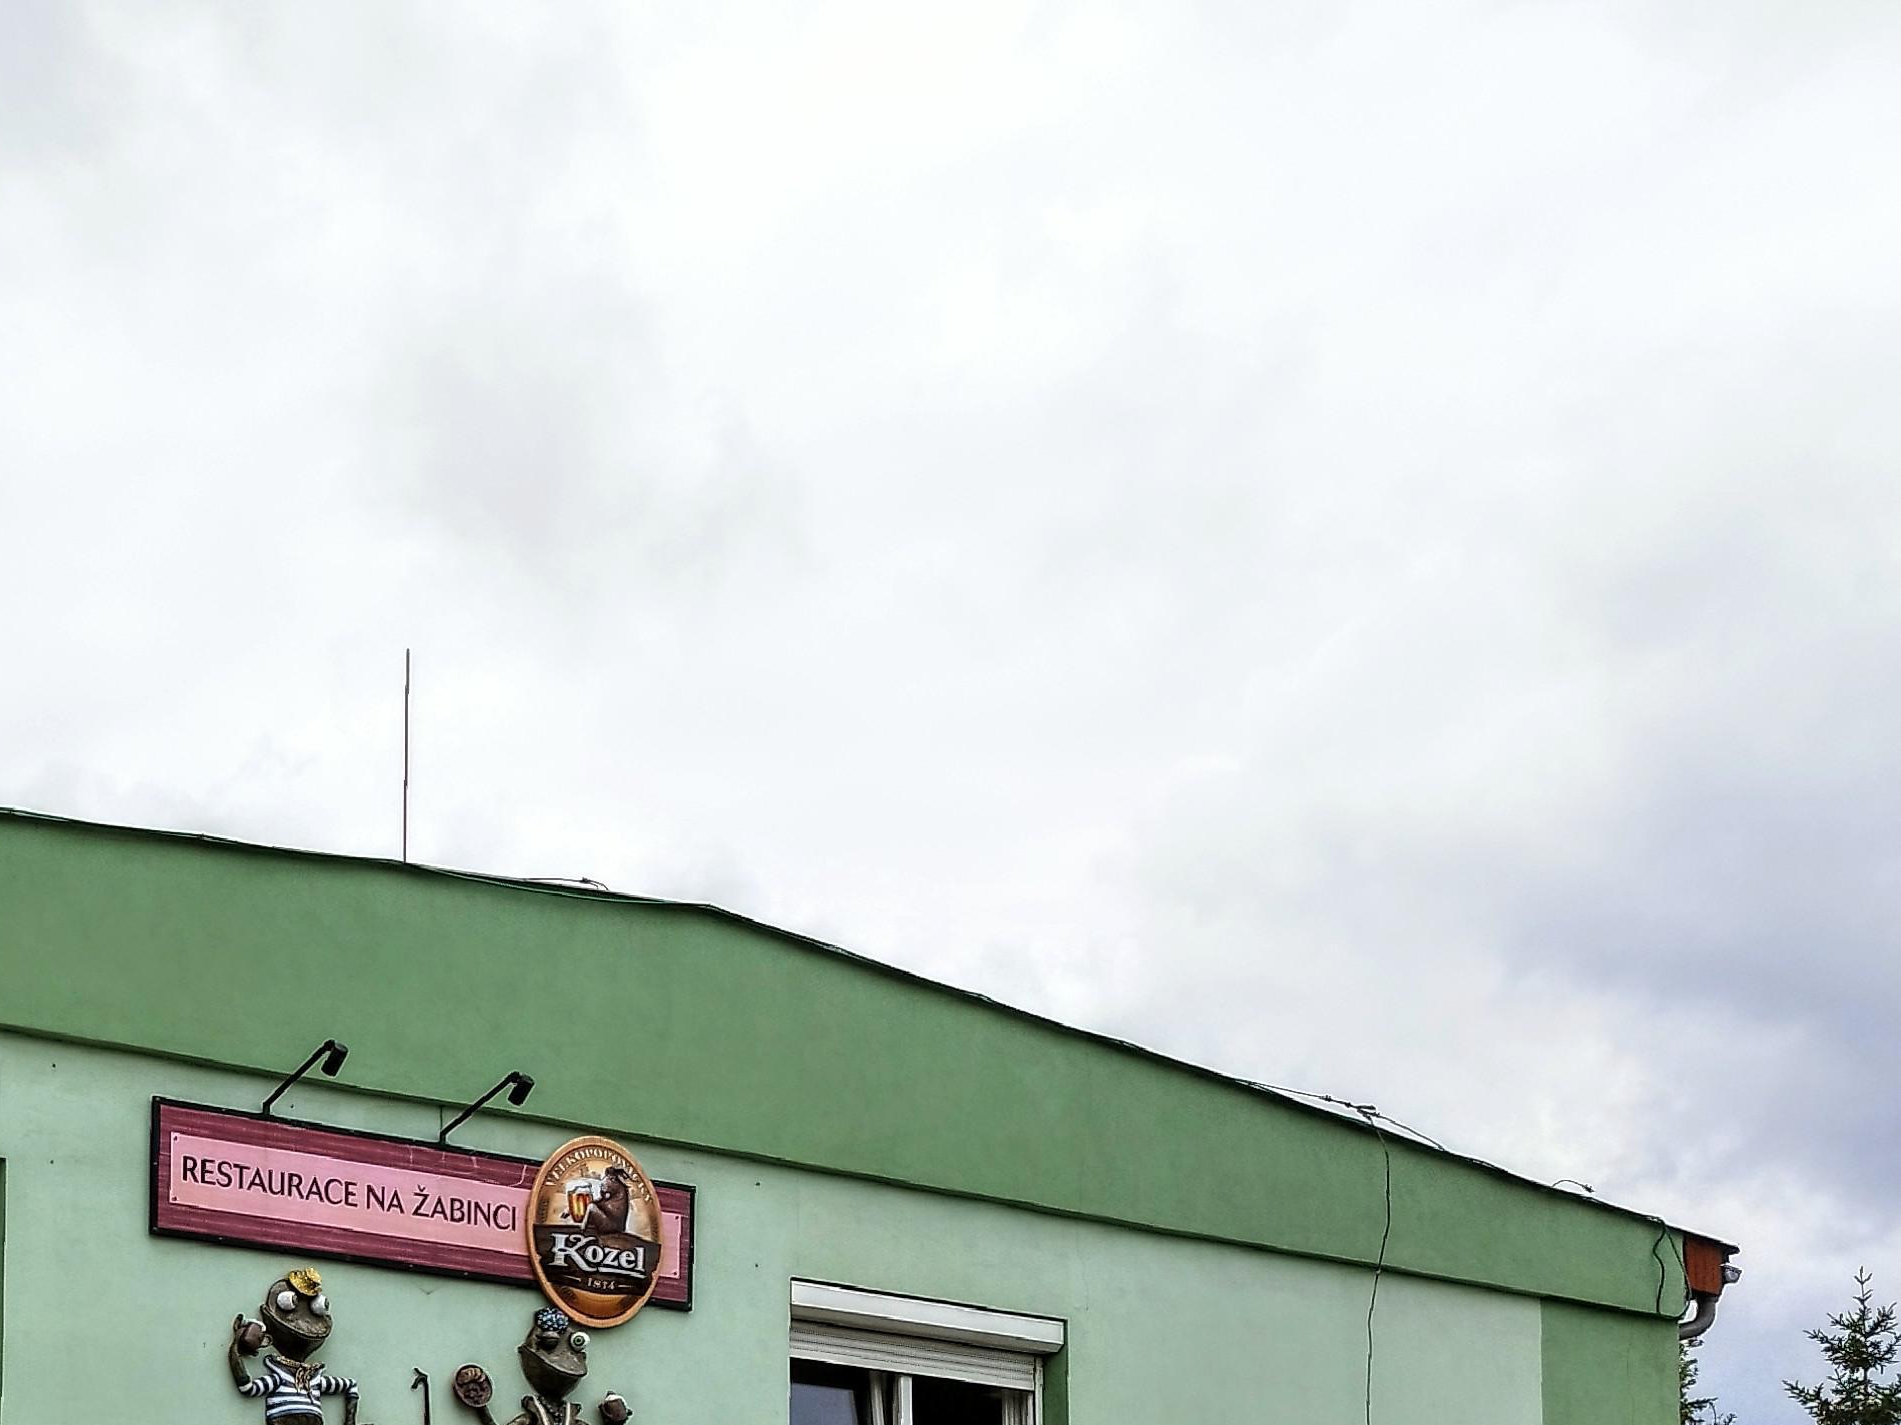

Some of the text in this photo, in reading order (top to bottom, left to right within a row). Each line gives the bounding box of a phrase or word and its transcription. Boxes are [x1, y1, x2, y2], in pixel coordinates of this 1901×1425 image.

[181, 1155, 518, 1233] RESTAURACE NA ŽABINCI
[548, 1232, 646, 1275] Kozel
